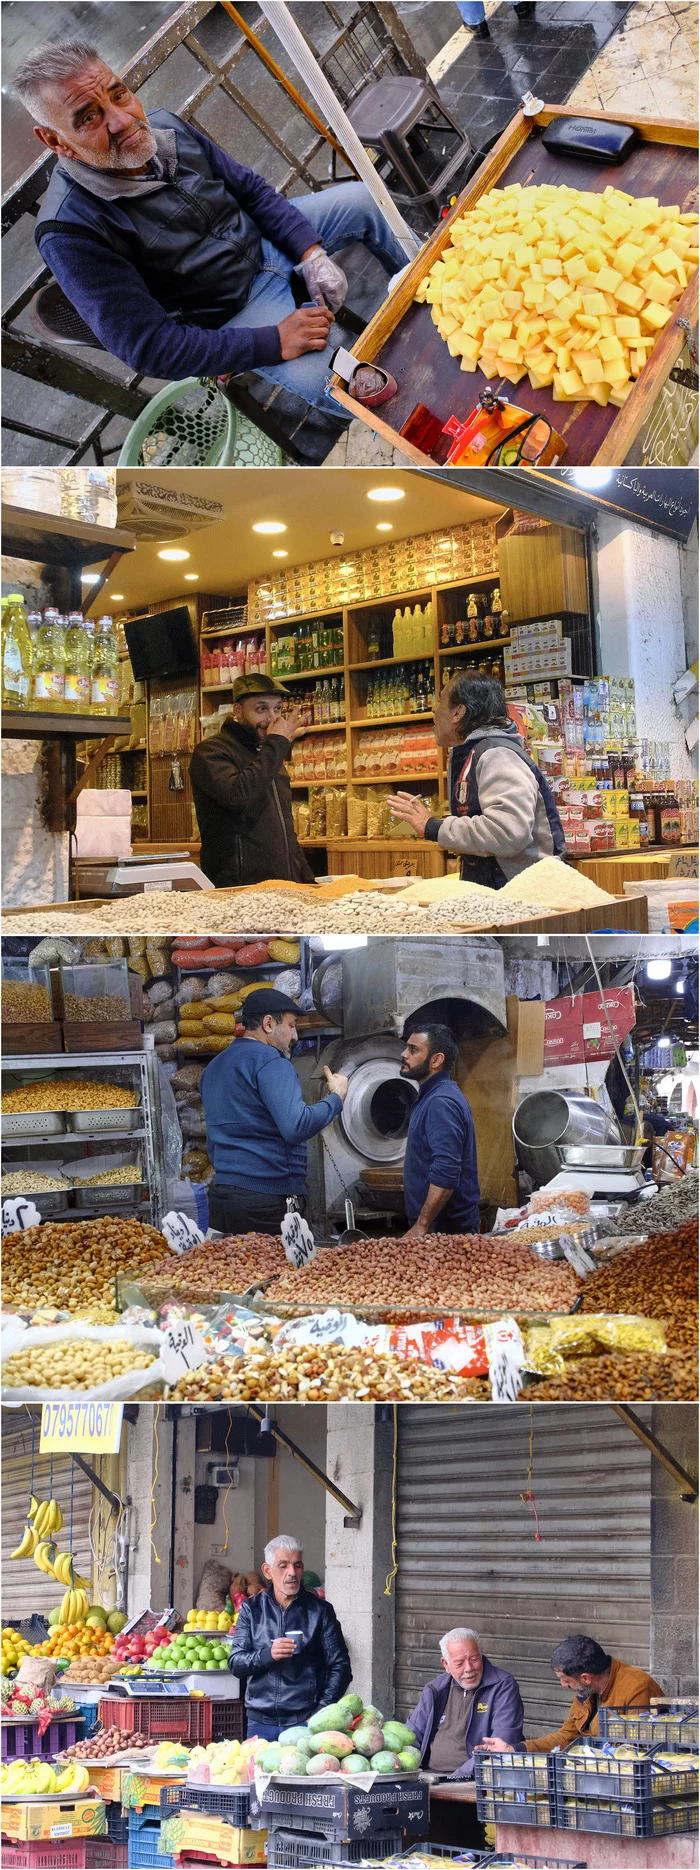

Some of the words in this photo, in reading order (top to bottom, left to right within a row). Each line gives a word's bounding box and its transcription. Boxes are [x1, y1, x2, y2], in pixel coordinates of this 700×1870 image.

[262, 1789, 304, 1805] PRODUCT
[304, 1793, 336, 1809] FRESH
[354, 1792, 397, 1805] PRODUCTS
[398, 1791, 423, 1803] FRESH
